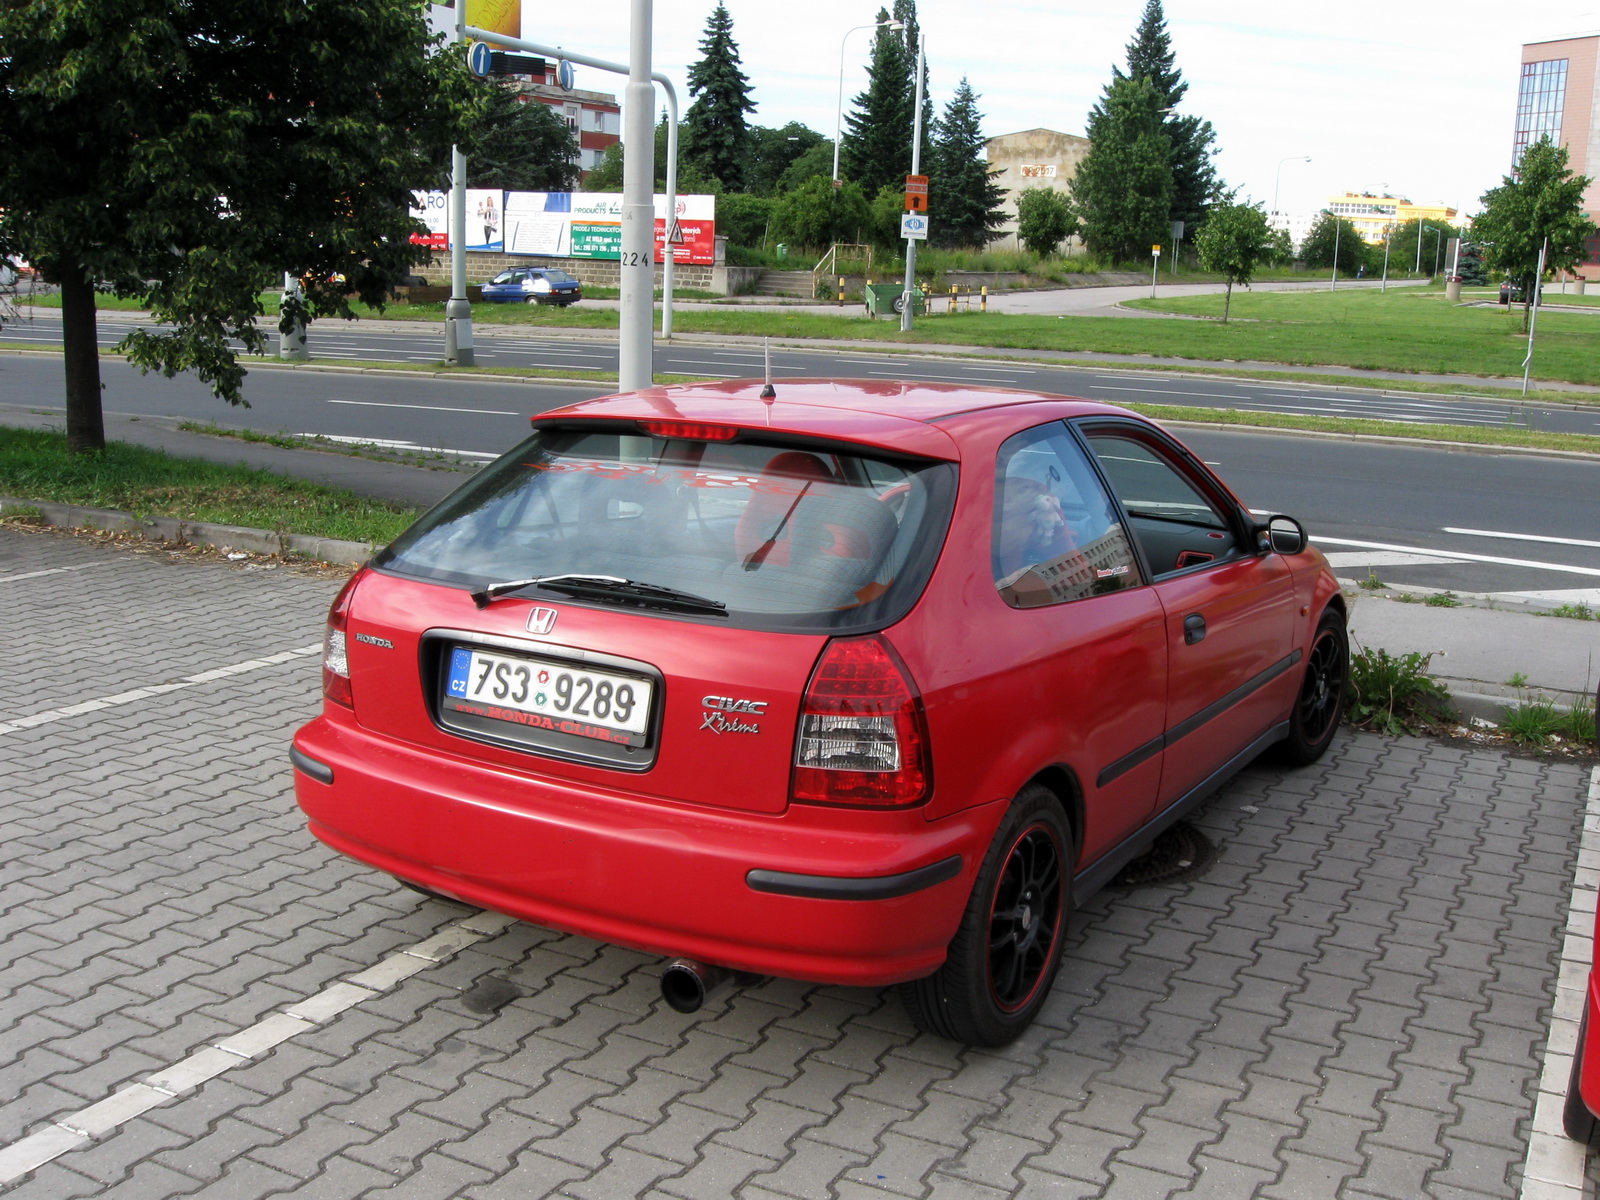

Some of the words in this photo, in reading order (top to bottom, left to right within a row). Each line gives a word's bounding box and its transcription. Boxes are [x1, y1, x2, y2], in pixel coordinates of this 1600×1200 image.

[573, 207, 607, 215] PRODUCTS
[355, 632, 395, 650] HONDA
[451, 679, 467, 693] CZ
[473, 658, 531, 704] 7S3
[553, 672, 637, 723] 9289
[701, 695, 769, 716] CIVIC
